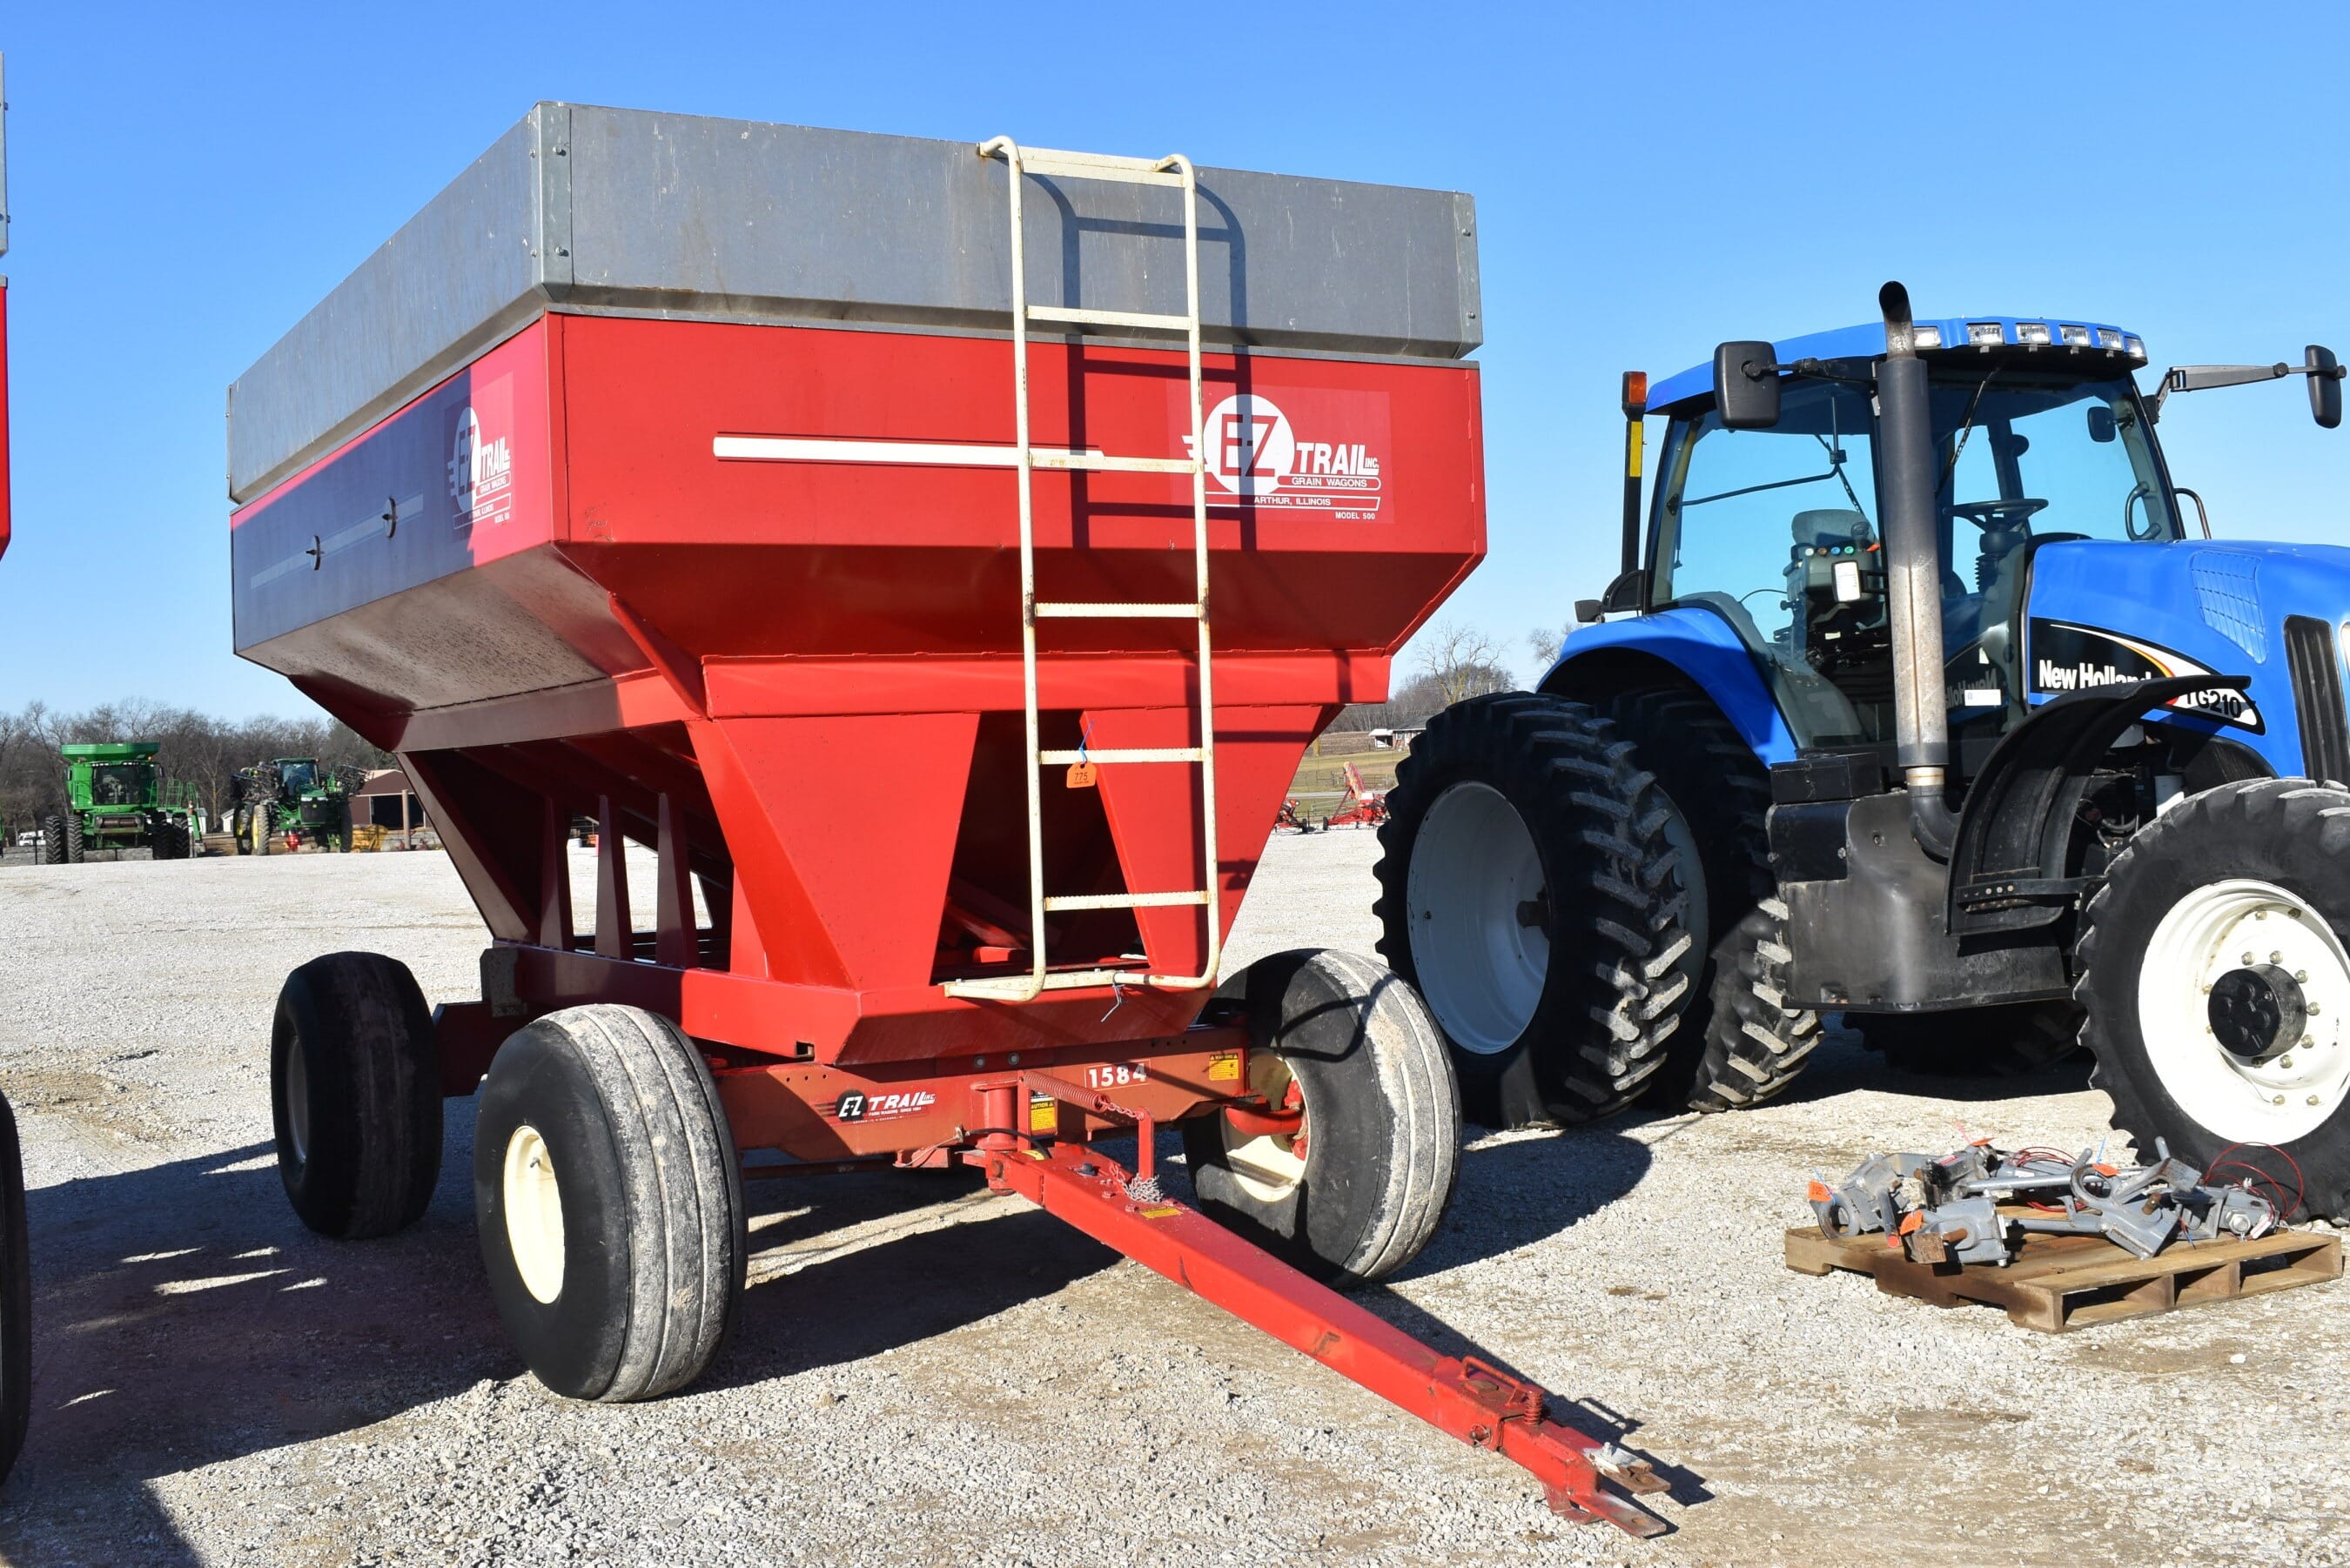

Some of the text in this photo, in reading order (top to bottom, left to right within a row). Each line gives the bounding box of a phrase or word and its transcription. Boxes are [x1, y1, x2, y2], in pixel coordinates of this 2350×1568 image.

[480, 436, 511, 480] TRAIL
[1296, 441, 1380, 476] TRAIL
[1292, 477, 1368, 488] GRAIN WAGONS
[1254, 495, 1332, 506] ARTHUR, ILLINOIS
[1335, 512, 1360, 520] MODEL
[2038, 659, 2078, 690] New
[1089, 1063, 1147, 1089] 1584
[869, 1091, 935, 1111] TRAIL
